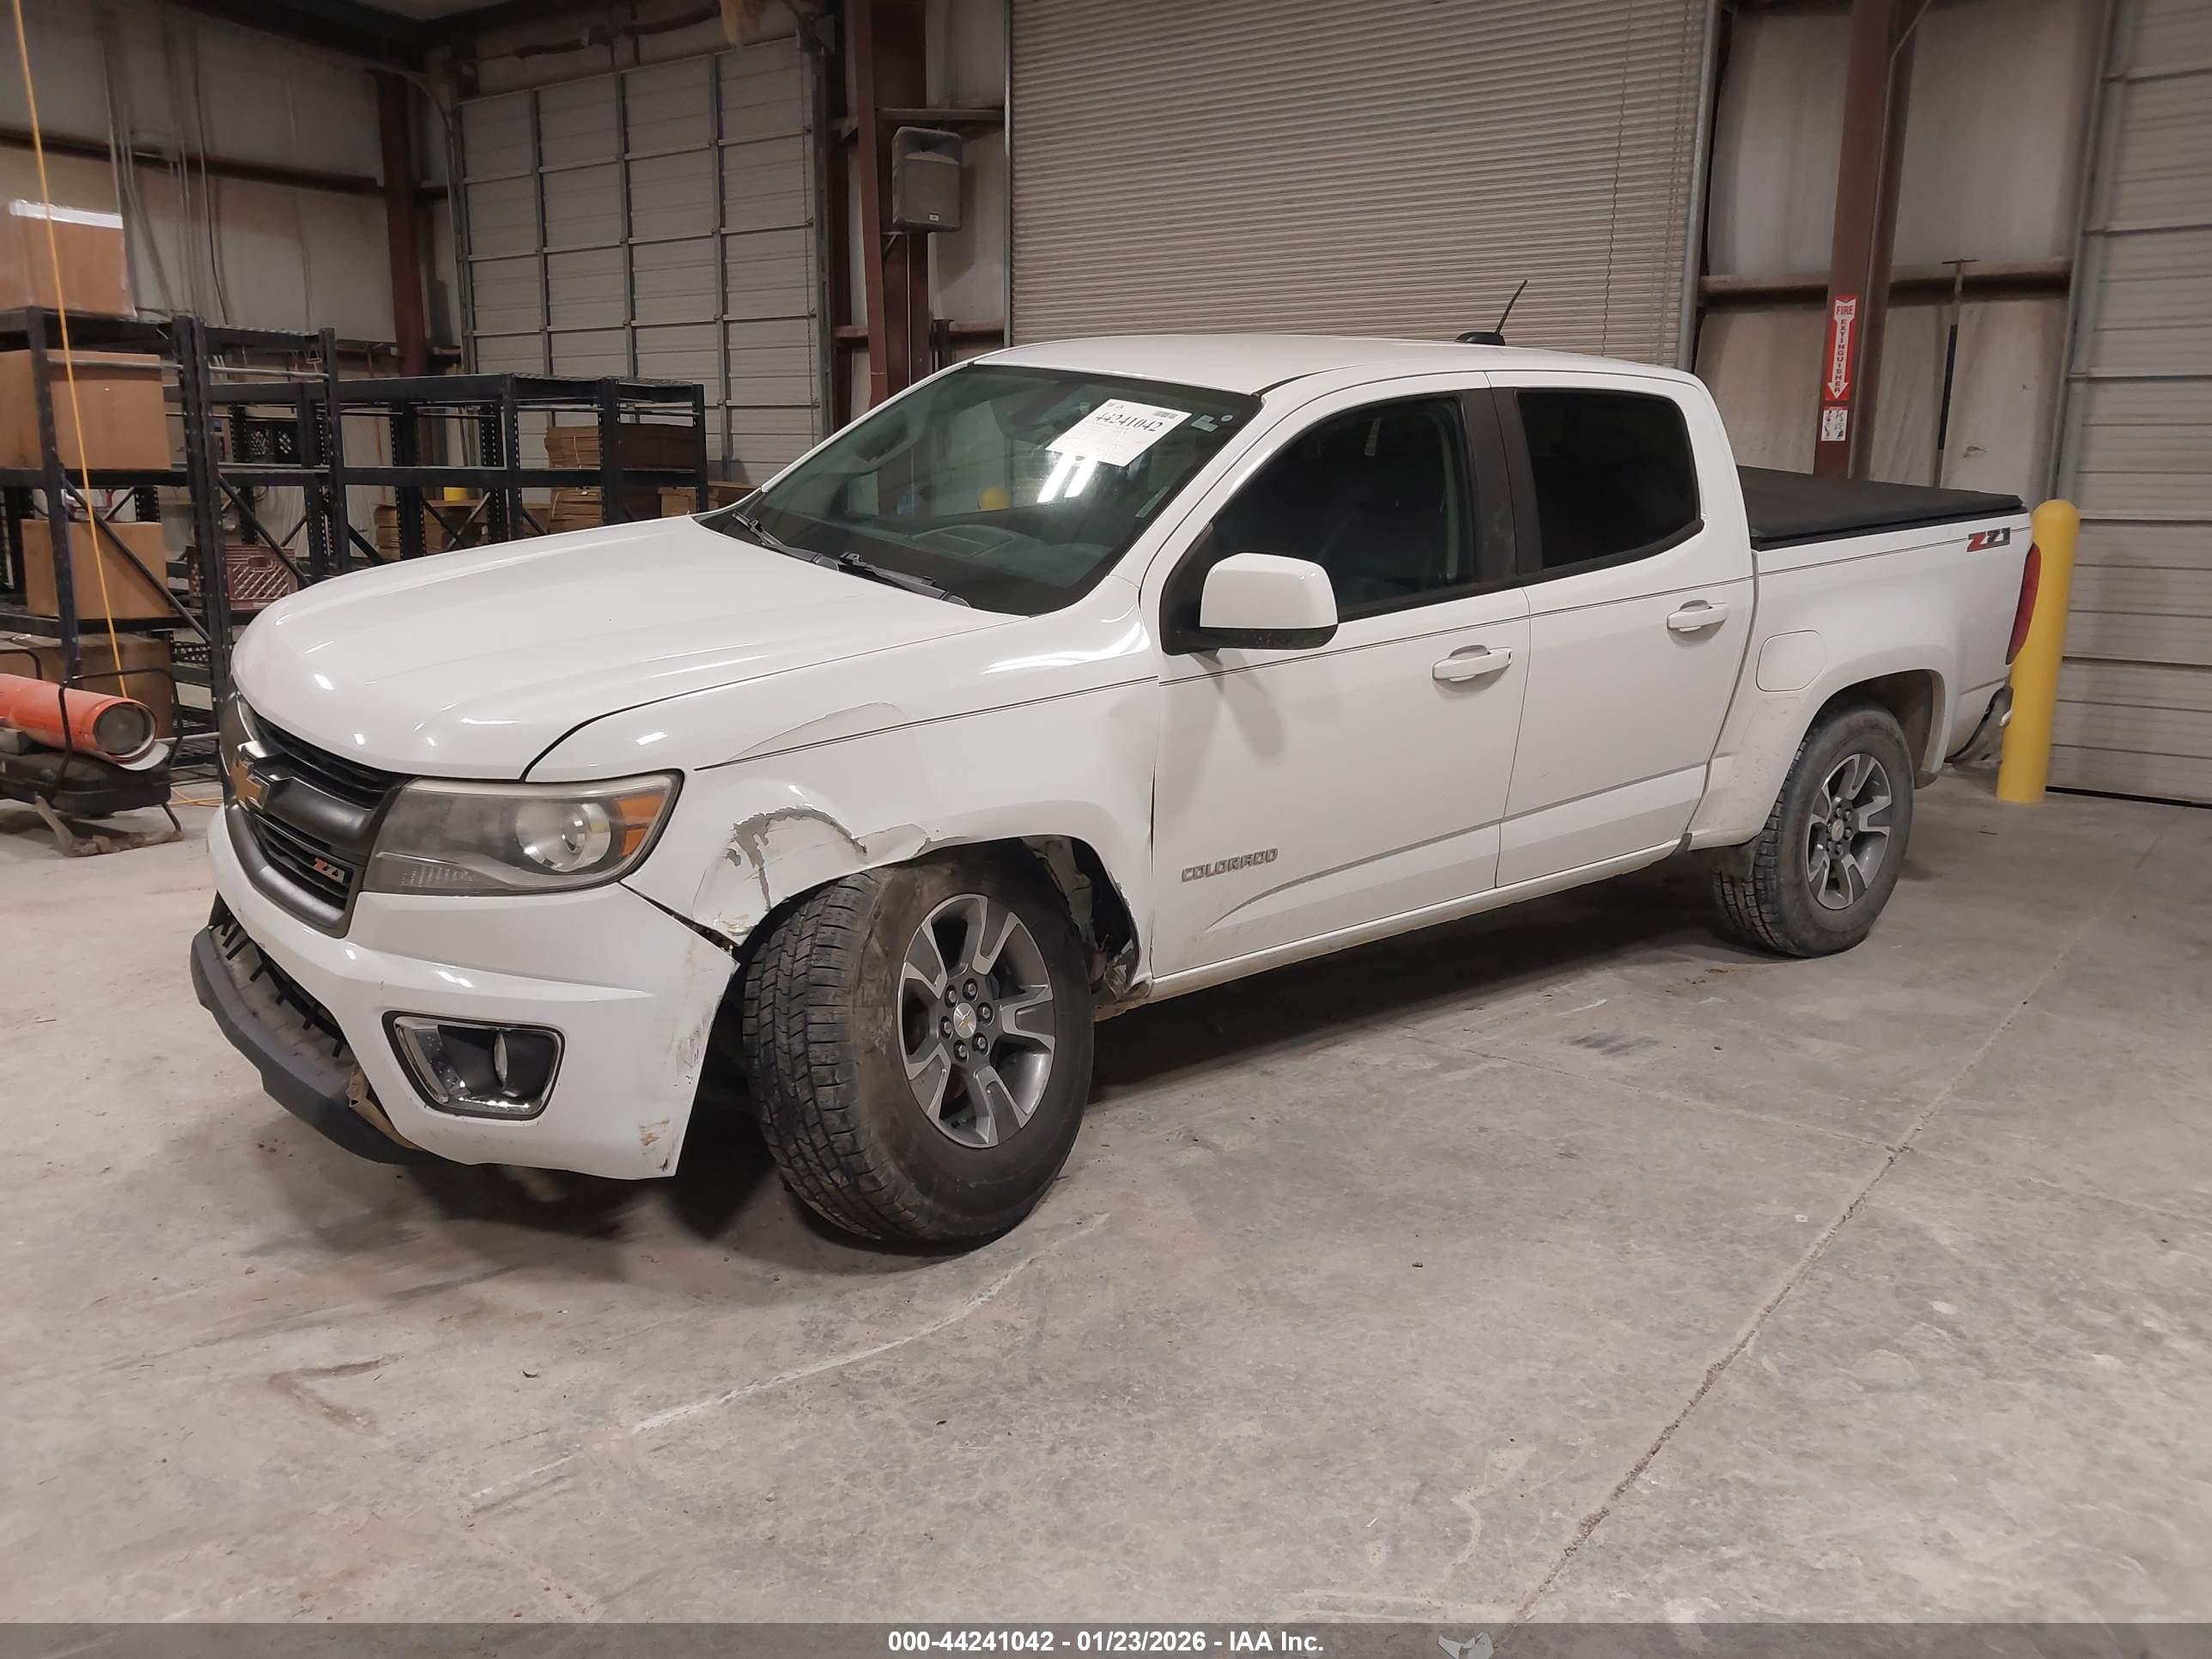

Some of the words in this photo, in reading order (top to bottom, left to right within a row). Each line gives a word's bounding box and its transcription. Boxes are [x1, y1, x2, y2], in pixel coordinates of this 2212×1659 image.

[1836, 305, 1854, 315] FIRE
[1834, 319, 1847, 393] EXTINGUISHER
[1096, 412, 1164, 432] 44241042
[1966, 526, 2011, 553] Z71
[1181, 848, 1279, 883] COLORADO
